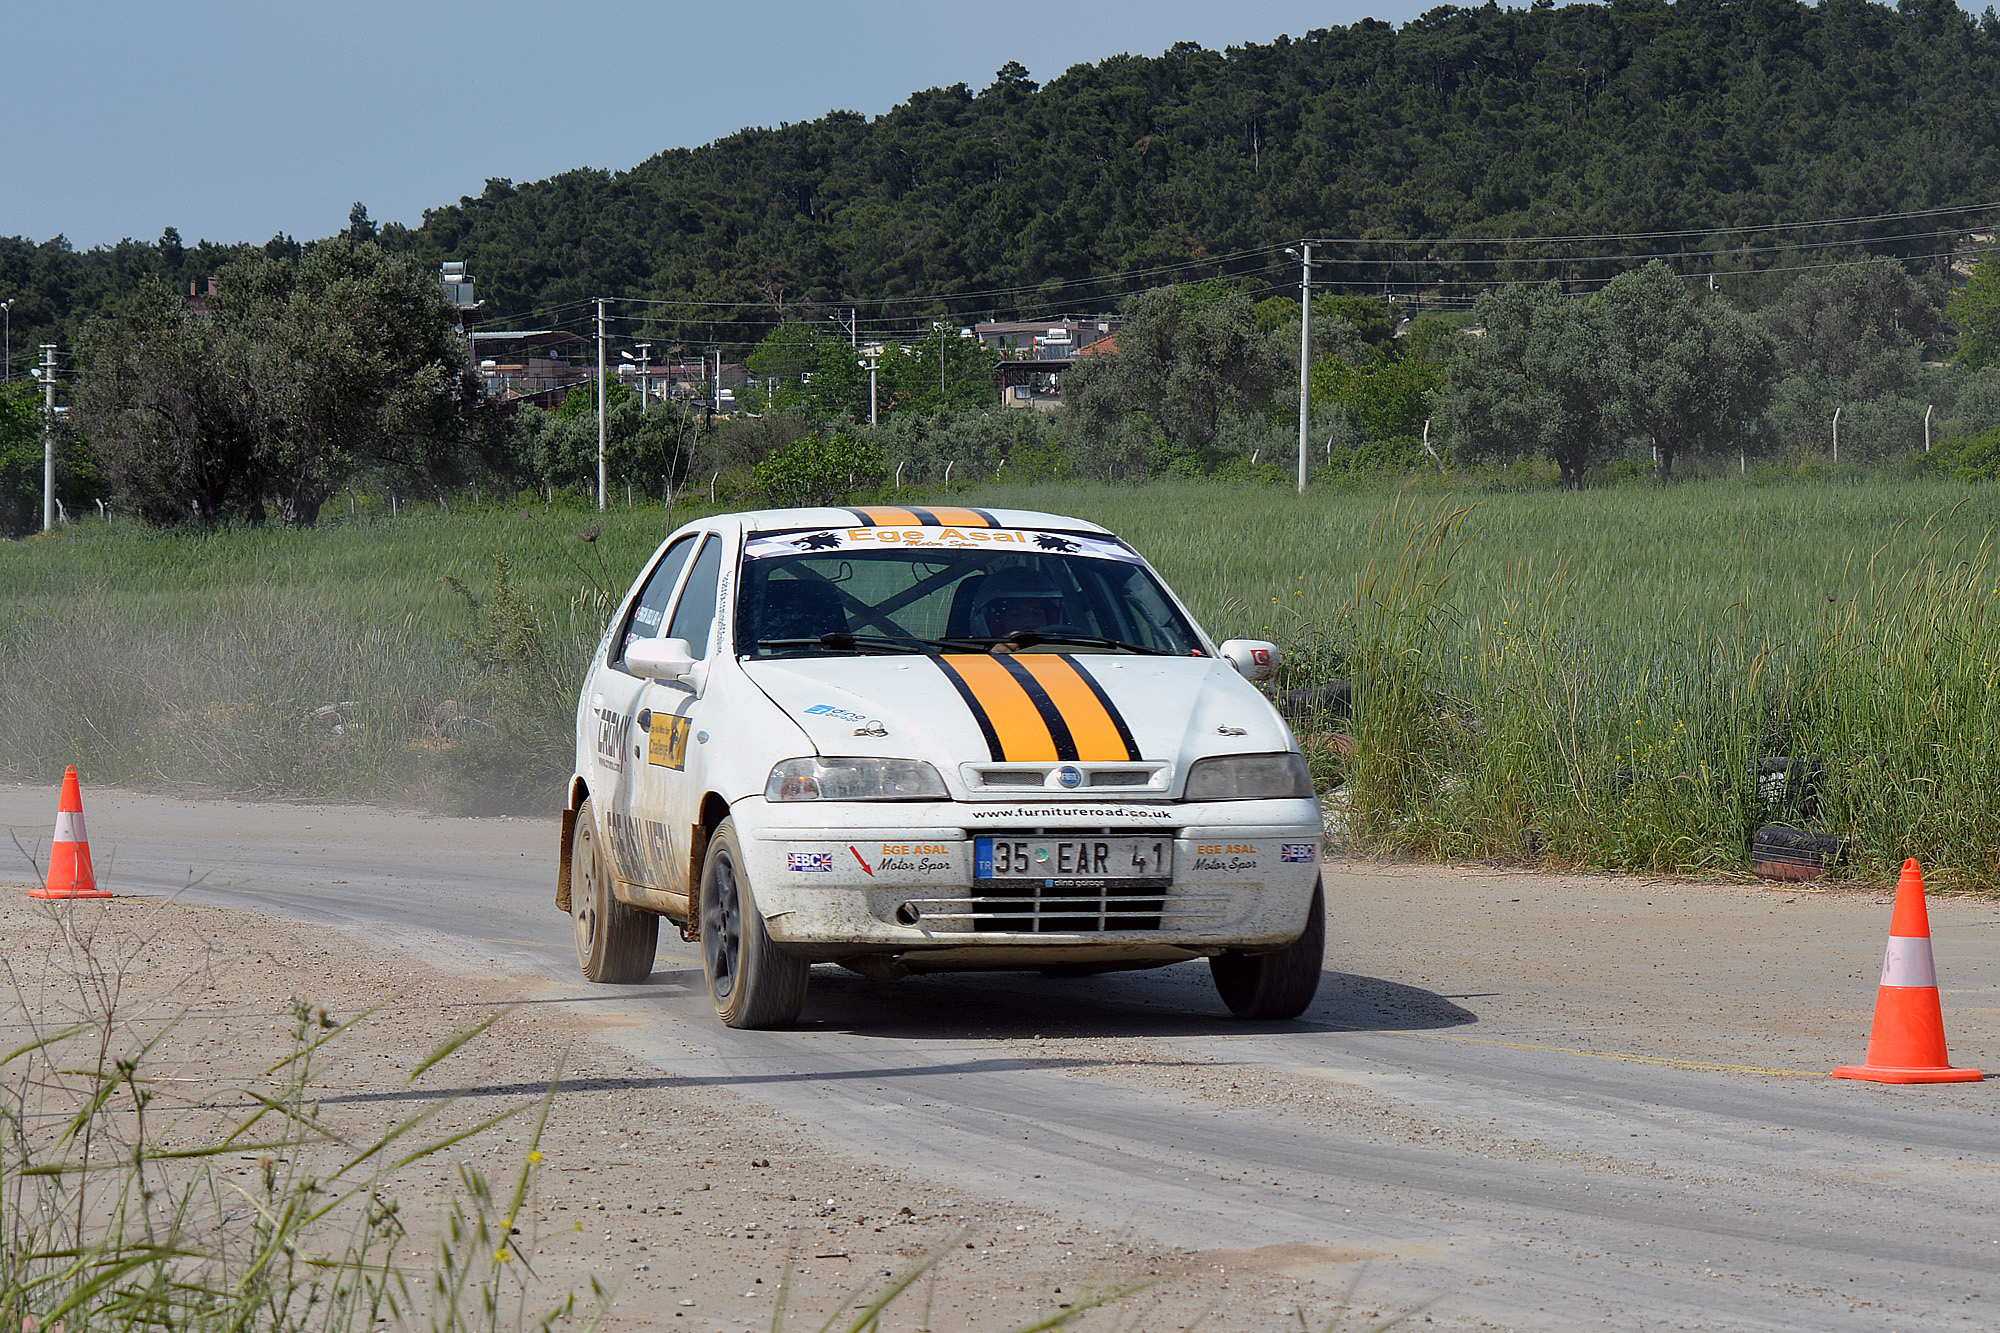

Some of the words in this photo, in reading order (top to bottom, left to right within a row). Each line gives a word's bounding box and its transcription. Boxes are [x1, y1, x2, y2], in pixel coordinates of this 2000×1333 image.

[847, 528, 924, 543] Ege
[939, 528, 1026, 543] Asal
[972, 807, 1172, 819] www.furnitureroad.co.uk
[882, 845, 909, 855] EGE
[913, 845, 949, 855] ASAL
[1197, 845, 1222, 855] EGE
[1225, 844, 1256, 854] ASAL
[1290, 845, 1313, 858] EBC
[794, 854, 820, 867] EBC
[979, 860, 992, 870] TR
[995, 842, 1029, 873] 35
[1058, 842, 1108, 874] EAR
[1192, 858, 1228, 872] Motor
[1229, 856, 1257, 873] Spor
[877, 858, 914, 871] Motor
[918, 857, 951, 874] Spor
